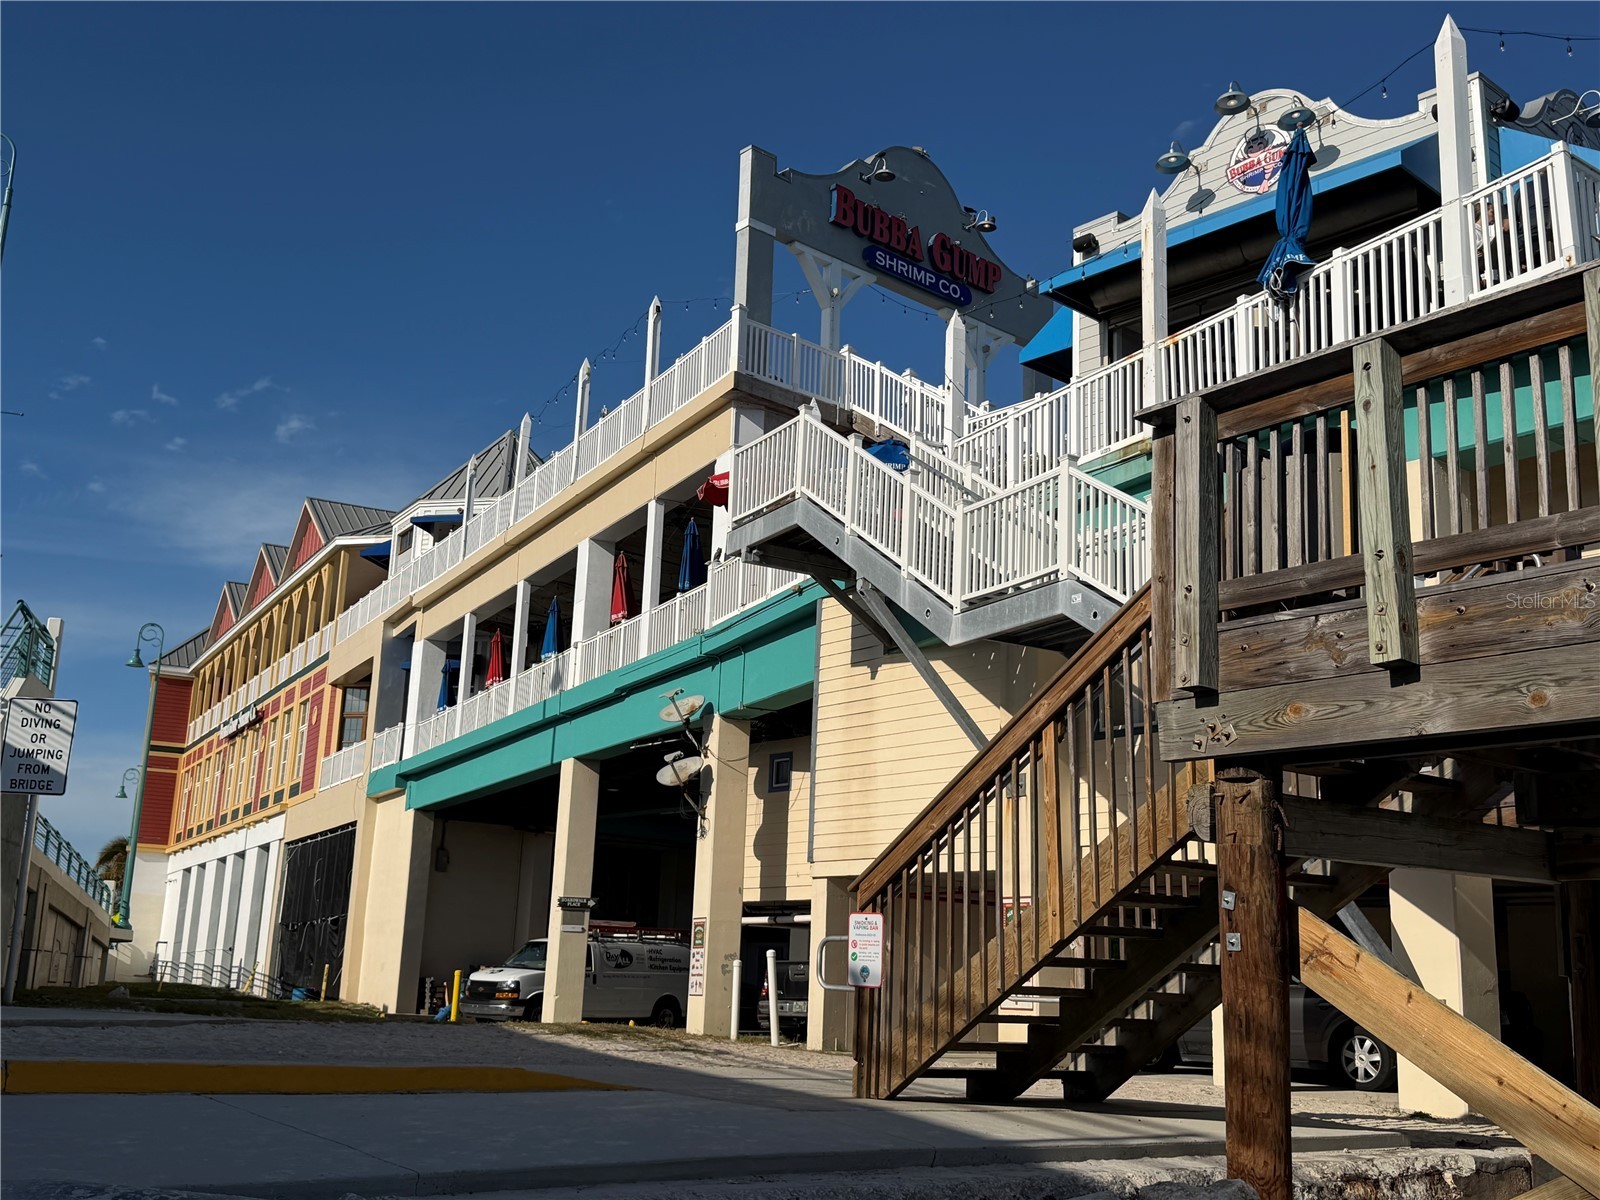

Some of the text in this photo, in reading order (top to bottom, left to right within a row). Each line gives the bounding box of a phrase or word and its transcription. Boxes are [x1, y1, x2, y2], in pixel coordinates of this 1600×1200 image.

[829, 184, 1001, 293] BUBBA GUMP
[875, 251, 964, 301] SHRIMP CO.
[35, 703, 52, 714] NO
[21, 717, 61, 729] DIVING
[30, 733, 47, 743] OR
[9, 748, 63, 760] JUMPING
[17, 763, 50, 775] FROM
[9, 779, 54, 791] BRIDGE
